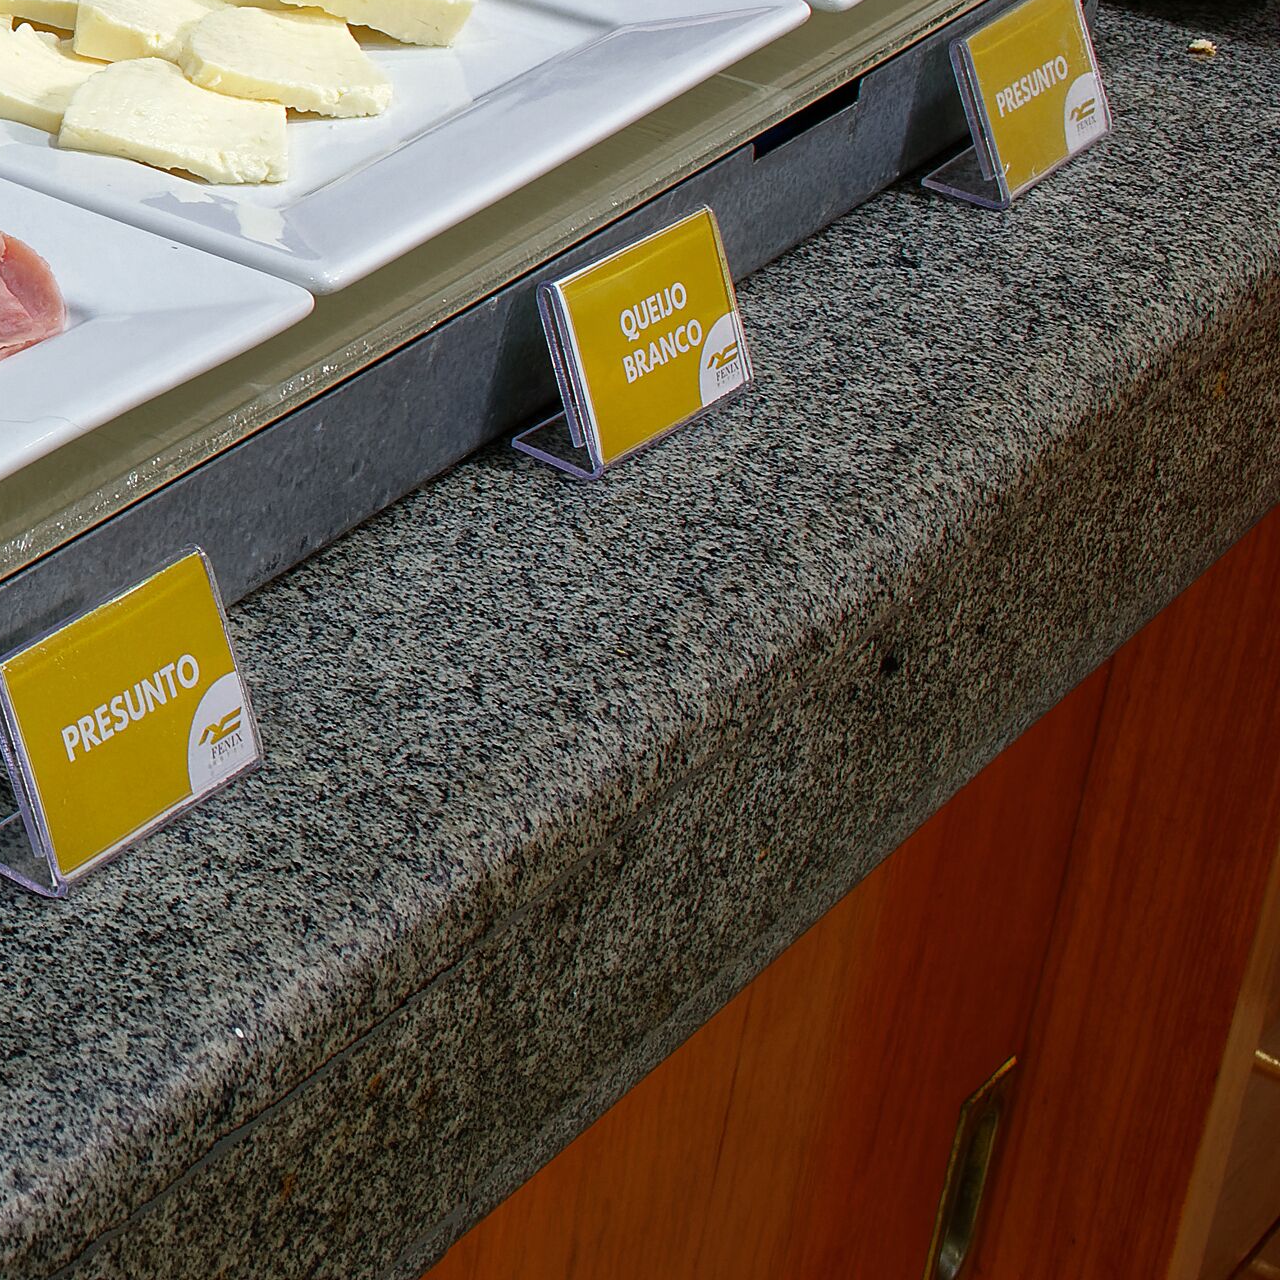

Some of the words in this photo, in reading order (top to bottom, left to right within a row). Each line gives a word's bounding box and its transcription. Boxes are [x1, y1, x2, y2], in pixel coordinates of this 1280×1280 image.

[995, 55, 1068, 118] PRESUNTO
[620, 282, 687, 341] QUEIJO
[622, 319, 702, 384] BRANCO
[61, 654, 200, 763] PRESUNTO
[212, 730, 242, 759] FENIX
